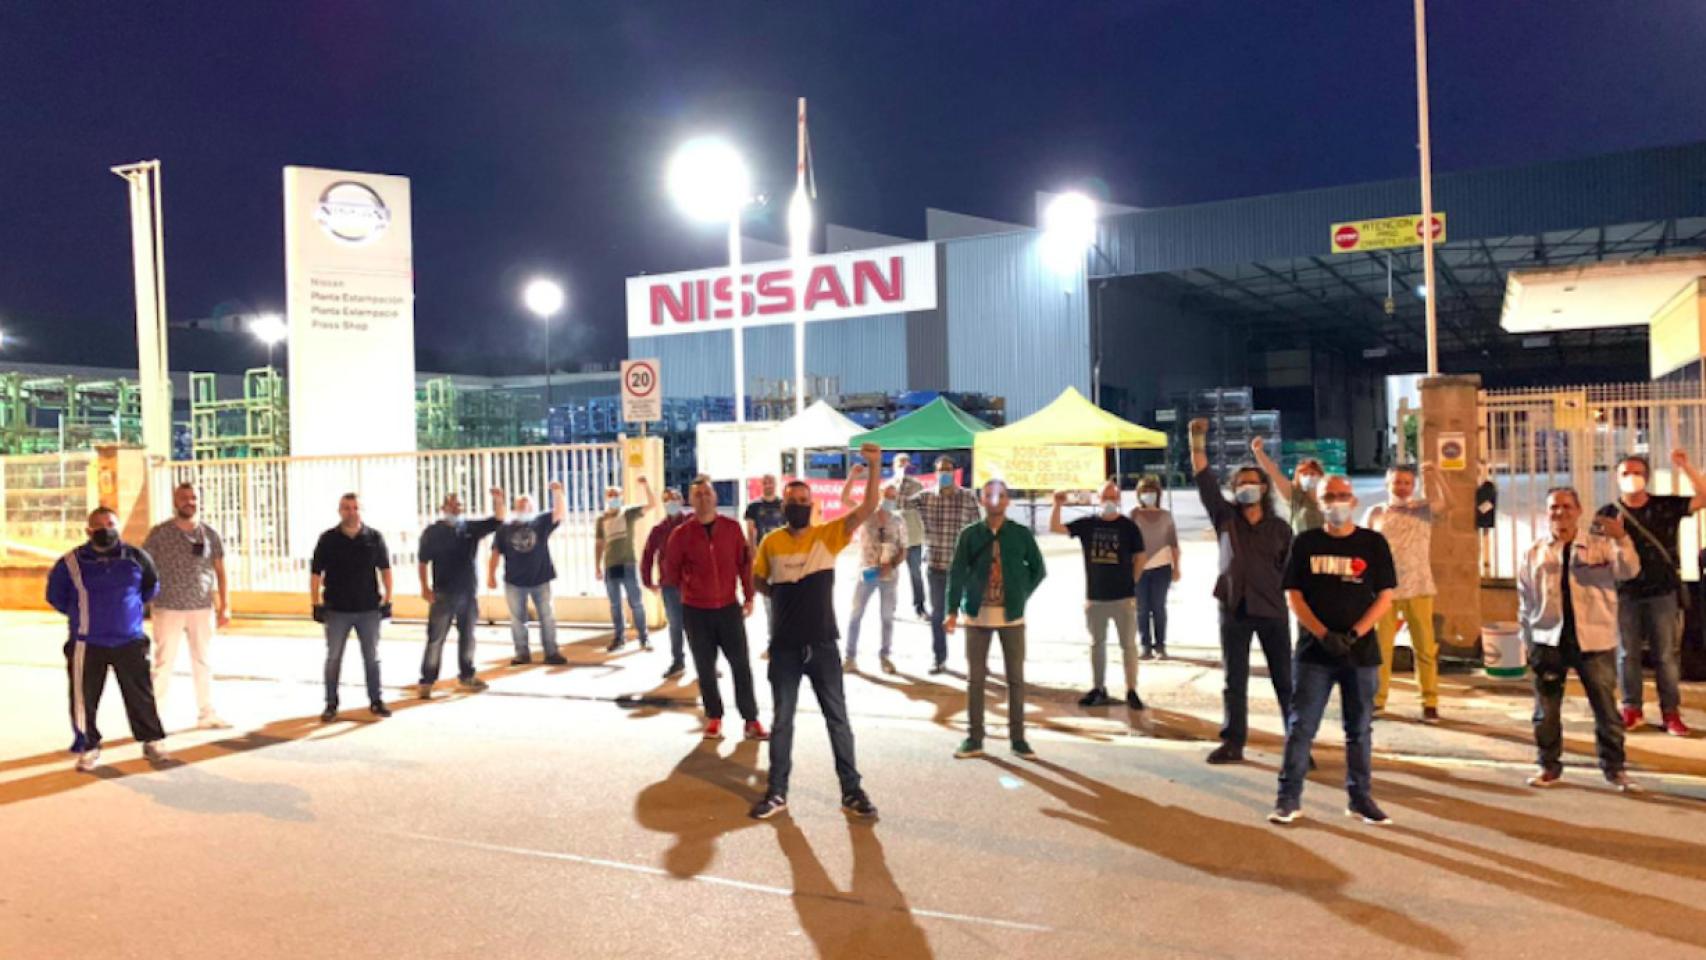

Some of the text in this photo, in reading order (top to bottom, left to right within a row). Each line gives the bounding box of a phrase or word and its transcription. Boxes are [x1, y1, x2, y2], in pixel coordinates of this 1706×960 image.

[310, 291, 340, 302] Planta
[650, 256, 905, 326] NISSAN
[310, 306, 340, 316] Planta
[631, 371, 650, 387] 20
